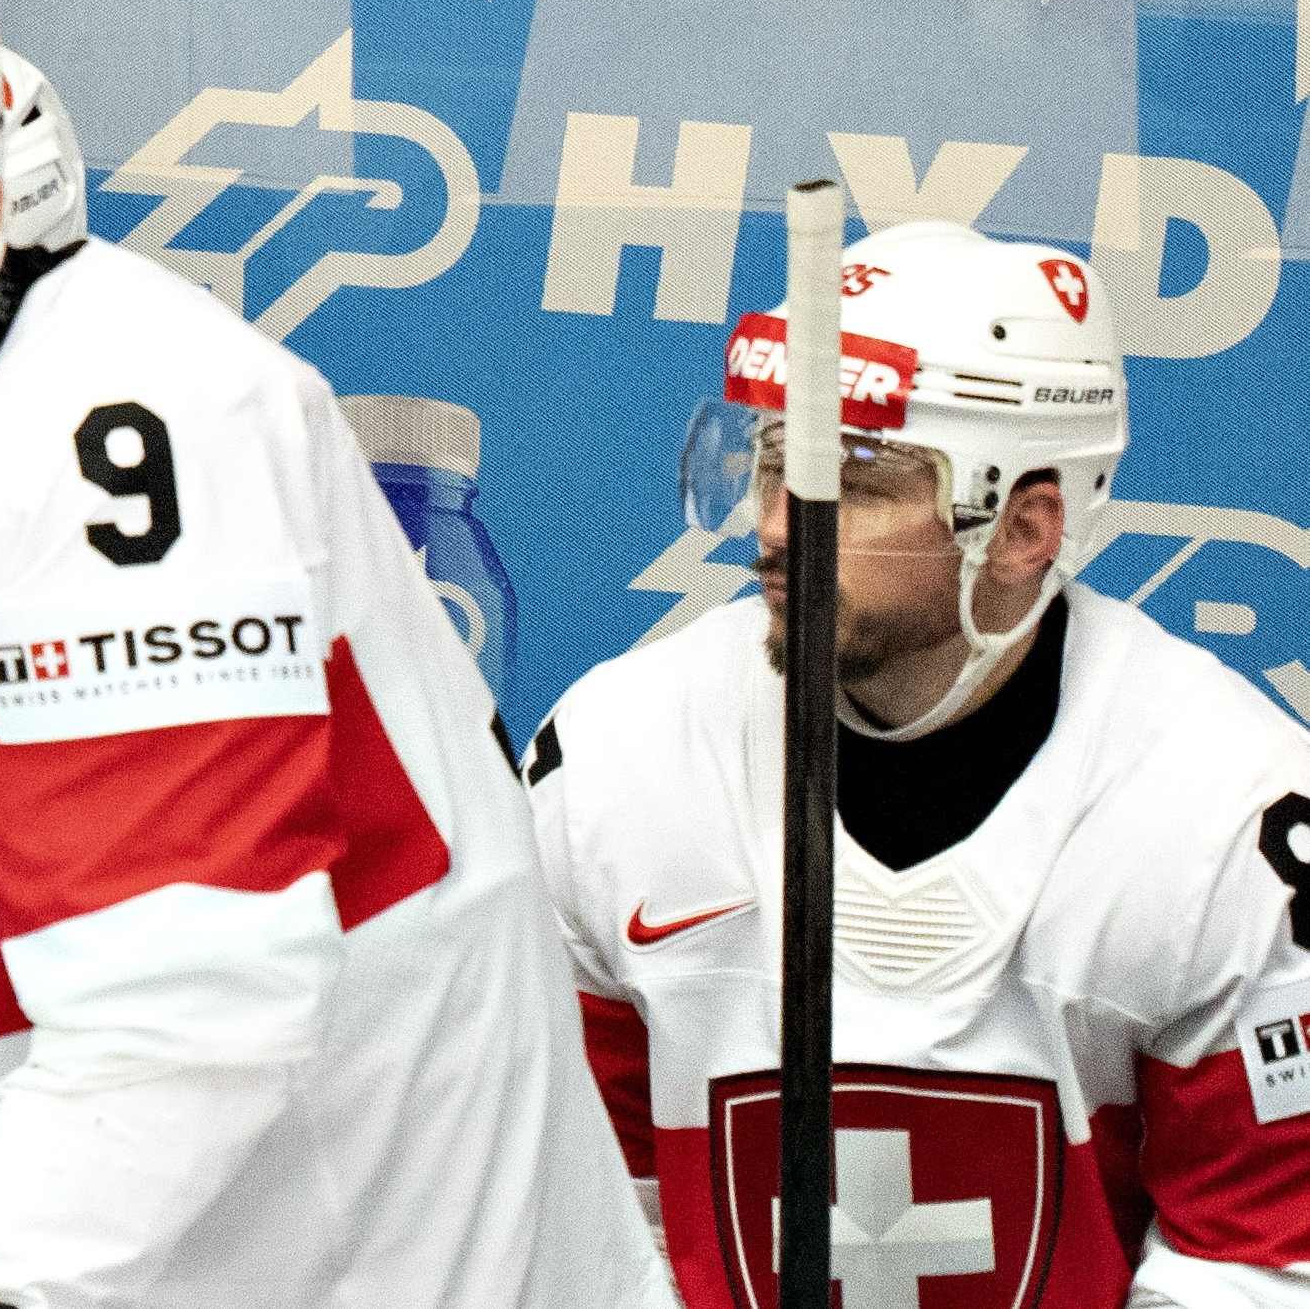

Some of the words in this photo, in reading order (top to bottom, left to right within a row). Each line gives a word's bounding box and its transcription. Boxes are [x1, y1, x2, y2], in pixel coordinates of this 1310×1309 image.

[729, 337, 901, 406] DENER
[73, 400, 182, 567] 9
[77, 614, 304, 674] TISSOT
